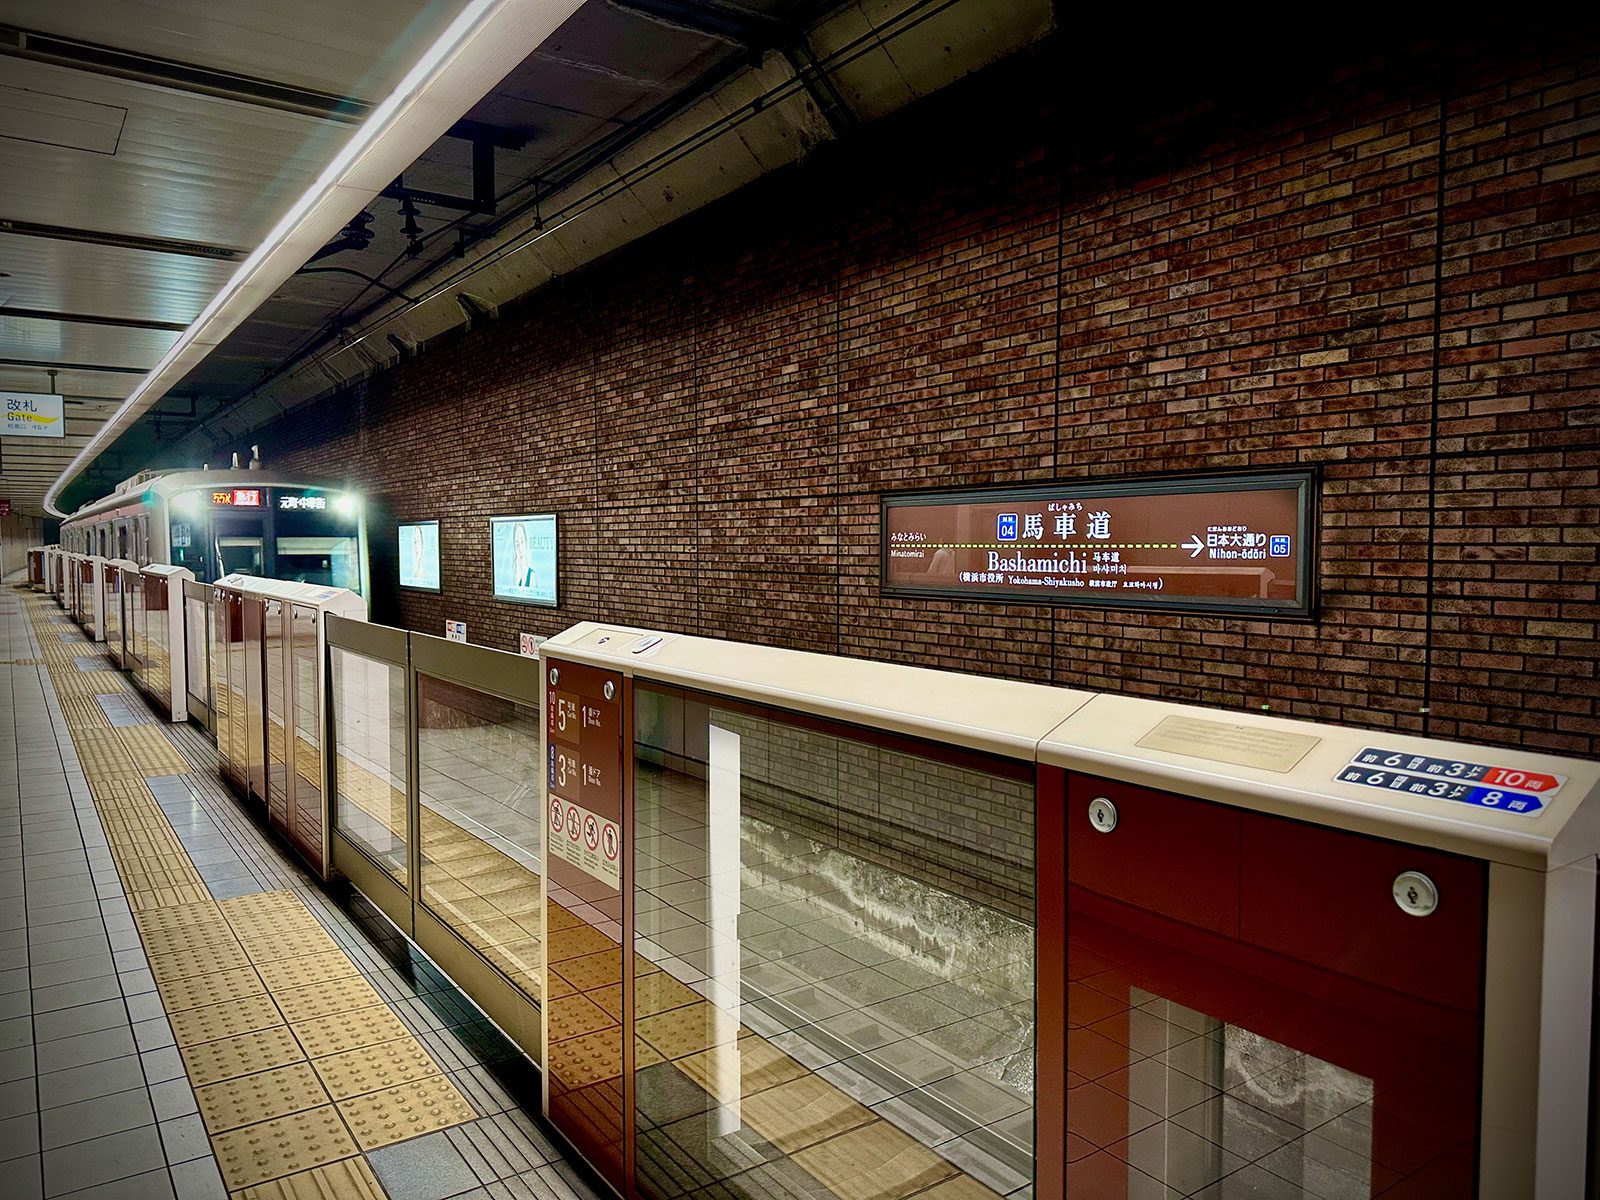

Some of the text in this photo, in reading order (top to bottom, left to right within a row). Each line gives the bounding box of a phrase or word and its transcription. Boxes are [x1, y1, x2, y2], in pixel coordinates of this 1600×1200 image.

[7, 399, 38, 412] 改札
[7, 412, 32, 422] Gate
[1048, 502, 1083, 512] ばしゃみち
[1001, 525, 1014, 537] 04
[1022, 511, 1112, 540] 馬車道
[890, 532, 927, 542] みなとみらい
[1207, 533, 1267, 547] 日本大通り
[890, 550, 925, 558] Minatomirai
[1273, 544, 1286, 554] 05
[987, 551, 1087, 574] Bashamichi
[1008, 576, 1085, 588] Yokohama-Shiyakusho
[549, 691, 556, 705] 10
[558, 699, 566, 731] 5
[582, 705, 587, 728] 1
[558, 754, 566, 787] 3
[582, 764, 587, 786] 1
